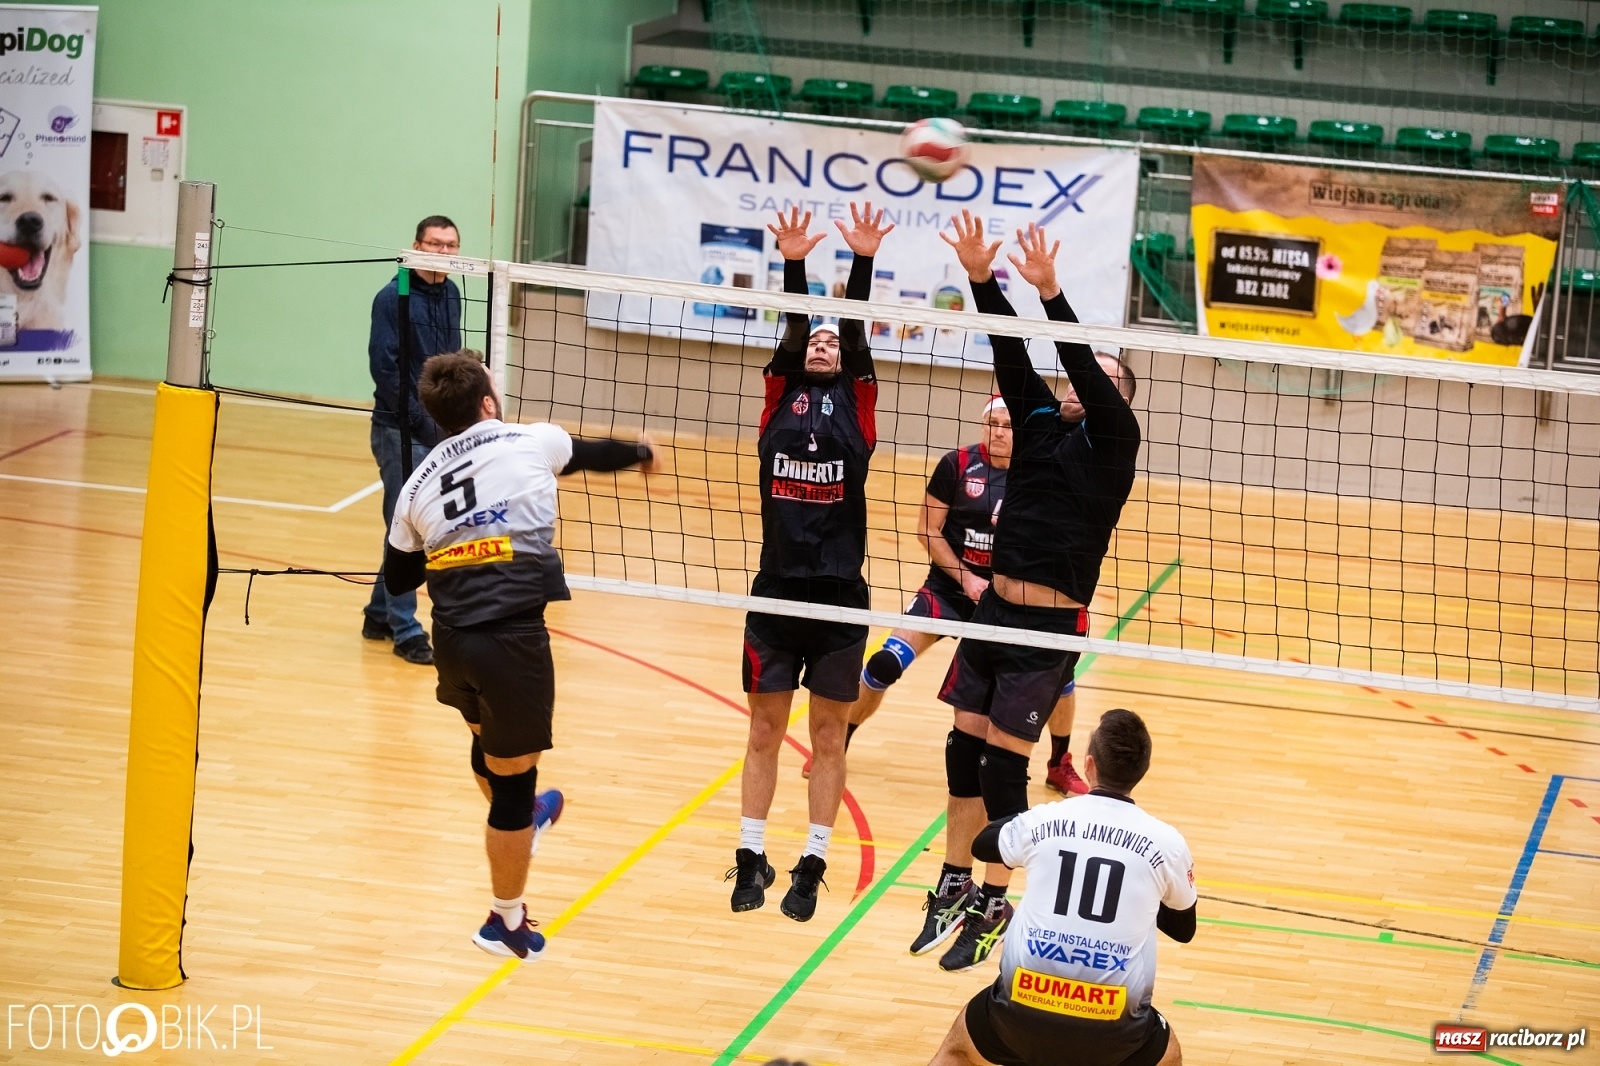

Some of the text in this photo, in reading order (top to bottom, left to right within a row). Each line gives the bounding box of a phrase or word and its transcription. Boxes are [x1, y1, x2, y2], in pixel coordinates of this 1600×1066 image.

[622, 129, 1086, 214] FRANCODEX
[440, 459, 477, 521] 5
[1082, 822, 1154, 858] JANKOWICE
[1053, 849, 1126, 924] 10
[1027, 939, 1131, 972] WAREX
[1028, 927, 1132, 956] SKLEP INSTALACYJNY
[1017, 991, 1118, 1015] MATERIAŁY BUDOWLANE
[1018, 972, 1120, 1006] BUMART
